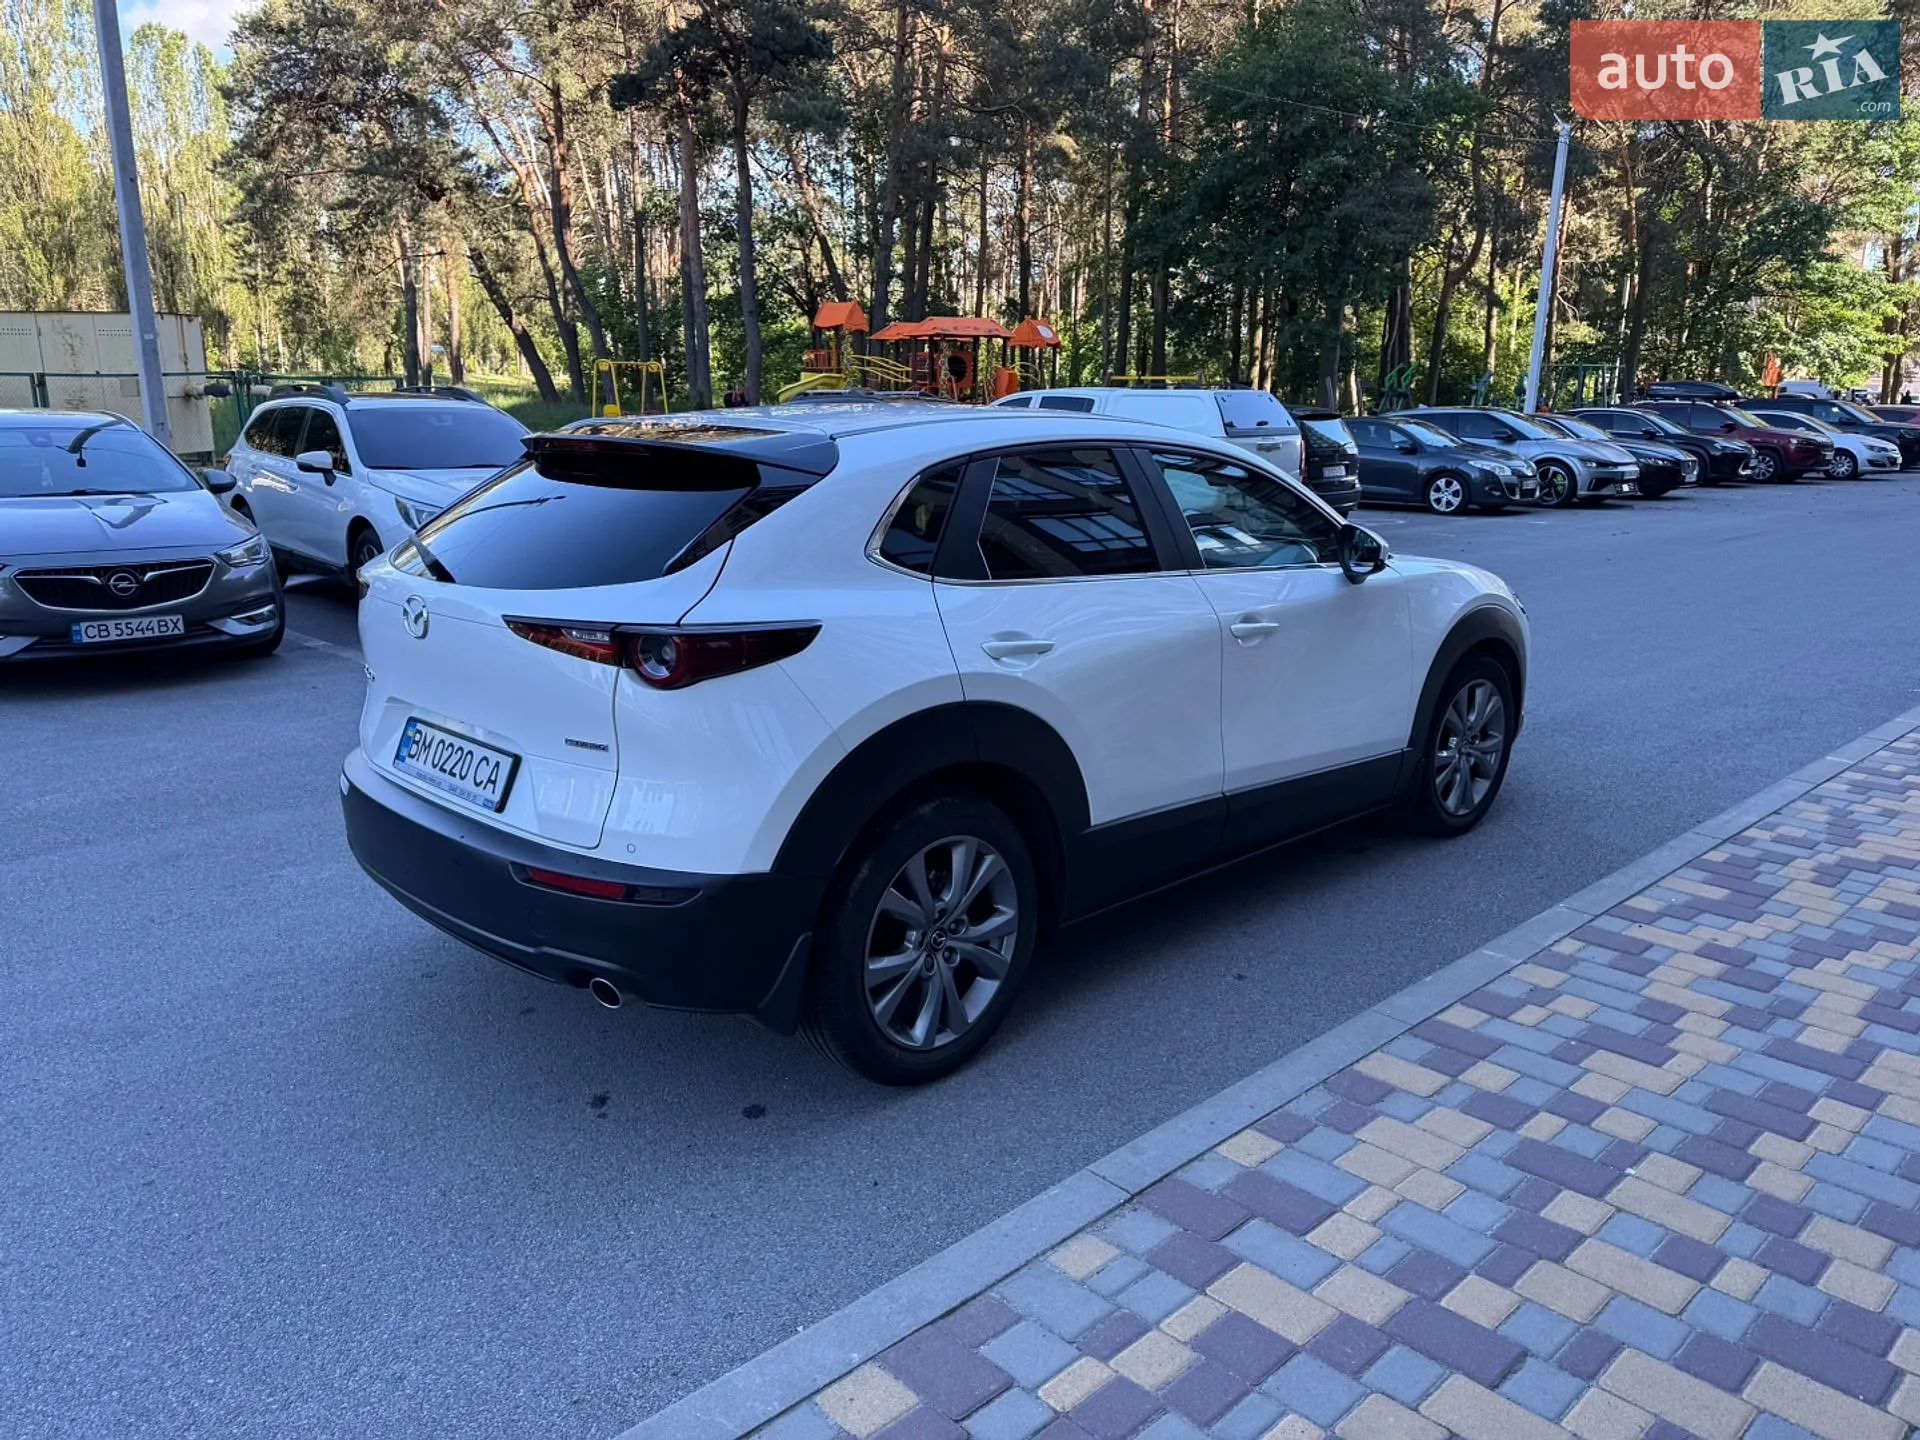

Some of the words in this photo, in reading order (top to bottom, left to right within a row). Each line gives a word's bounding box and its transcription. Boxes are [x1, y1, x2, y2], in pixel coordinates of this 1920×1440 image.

[84, 624, 111, 639] CB
[114, 620, 155, 637] 5544
[156, 618, 182, 633] BX
[407, 729, 435, 766] BM
[431, 738, 474, 781] 0220
[473, 756, 501, 794] CA
